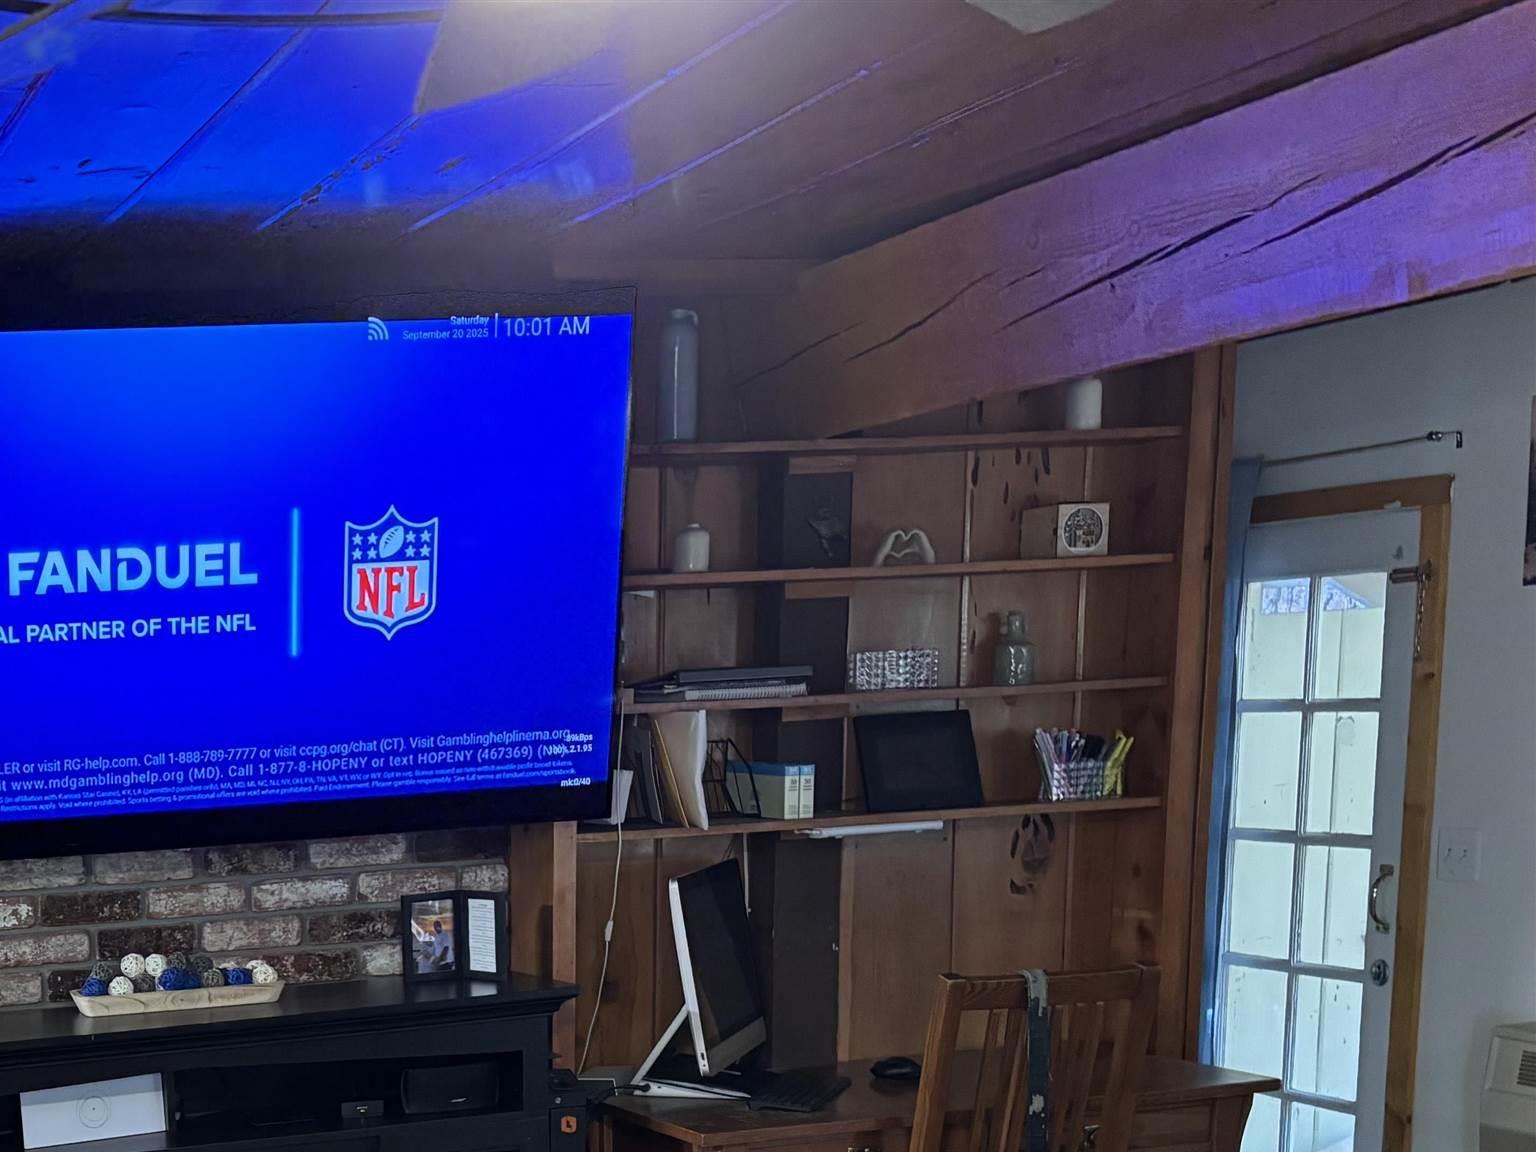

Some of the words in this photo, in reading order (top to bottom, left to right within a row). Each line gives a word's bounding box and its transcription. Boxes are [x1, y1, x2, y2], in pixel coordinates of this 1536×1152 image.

[402, 330, 450, 341] September
[452, 329, 464, 338] 20
[466, 328, 489, 338] 2025
[450, 315, 490, 326] Saturday
[503, 317, 550, 337] 10:01
[558, 315, 591, 336] AM
[8, 542, 258, 597] FANDUEL
[356, 565, 425, 619] NFL
[26, 620, 125, 643] PARTNER
[132, 618, 162, 638] OF
[167, 616, 210, 635] THE
[215, 614, 256, 633] NFL
[11, 770, 184, 791] www.mdgamblinghelp.org
[188, 766, 224, 782] (MD).
[228, 763, 253, 777] Call
[258, 756, 367, 776] 1-877-8-HOPENY
[372, 758, 385, 769] or
[389, 753, 414, 767] text
[417, 750, 473, 765] HOPENY
[477, 746, 533, 763] (467369)
[23, 764, 35, 774] or
[37, 759, 61, 773] visit
[63, 757, 141, 771] RG-help.com.
[144, 753, 165, 766] Call
[168, 747, 257, 765] 1-888-789-7777
[259, 749, 271, 759] or
[274, 745, 297, 758] visit
[299, 740, 377, 758] ccpg.org/chat
[410, 736, 434, 749] Visit
